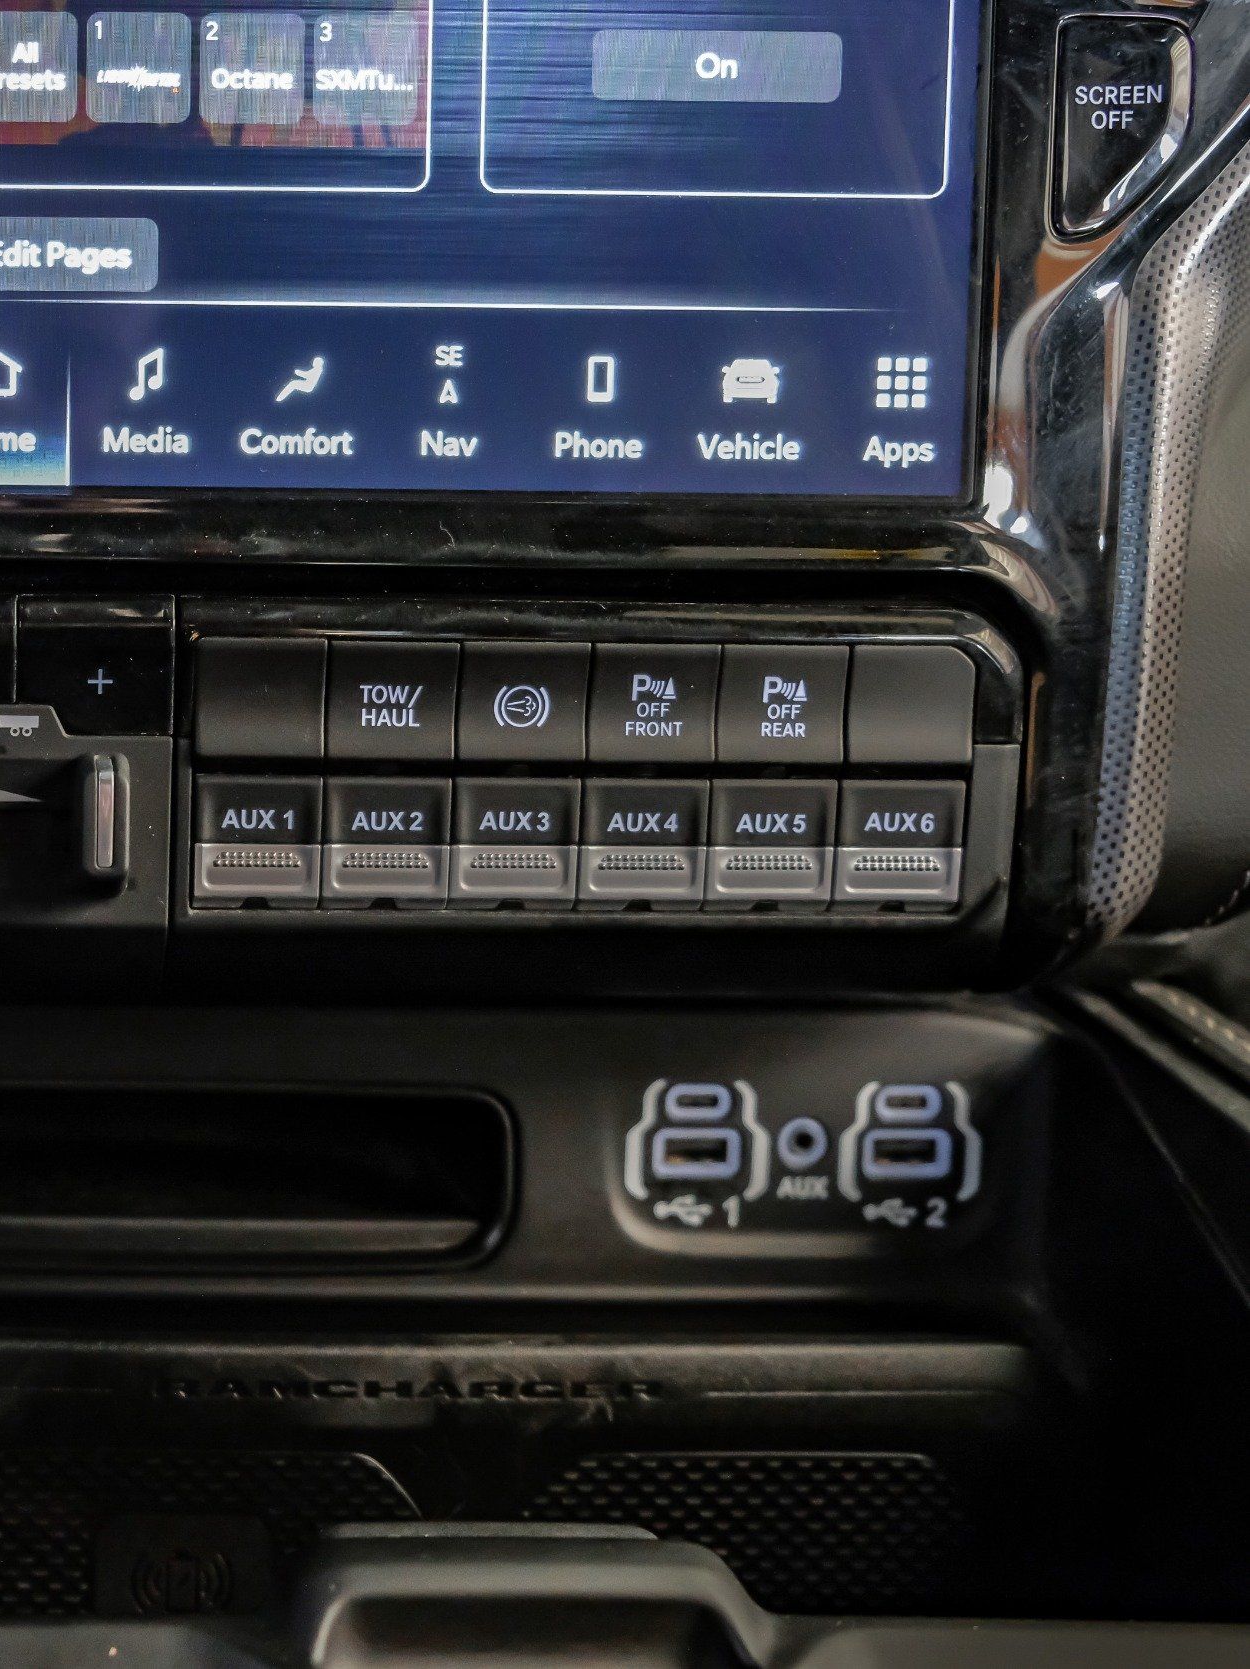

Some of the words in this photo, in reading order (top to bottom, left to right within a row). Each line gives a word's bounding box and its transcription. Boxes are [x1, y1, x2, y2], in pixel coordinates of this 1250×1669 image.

[94, 21, 103, 40] 1
[206, 22, 219, 41] 2
[319, 22, 333, 42] 3
[11, 42, 39, 65] All
[695, 52, 739, 79] On
[211, 68, 293, 91] Octane
[1074, 84, 1163, 105] SCREEN
[1090, 110, 1133, 130] OFF
[47, 242, 133, 275] Pages
[435, 345, 464, 367] SE
[102, 426, 191, 455] Media
[240, 428, 354, 456] Comfort
[420, 430, 479, 457] Nav
[554, 431, 642, 459] Phone
[697, 433, 801, 461] Vehicle
[862, 435, 935, 468] Apps
[360, 685, 424, 707] TOW/
[361, 708, 419, 728] HAUL
[637, 702, 670, 719] OFF
[767, 704, 801, 722] OFF
[625, 721, 683, 738] FRONT
[761, 723, 806, 738] REAR
[221, 809, 274, 830] AUX
[282, 809, 294, 830] 1
[351, 810, 405, 831] AUX
[408, 810, 423, 831] 2
[478, 810, 533, 832] AUX
[535, 810, 550, 832] 3
[607, 812, 660, 833] AUX
[661, 812, 679, 833] 4
[735, 813, 789, 834] AUX
[791, 813, 806, 834] 5
[864, 812, 917, 834] AUX
[918, 812, 934, 834] 6
[776, 1176, 829, 1200] AUX
[721, 1196, 740, 1228] 1
[924, 1200, 948, 1229] 2
